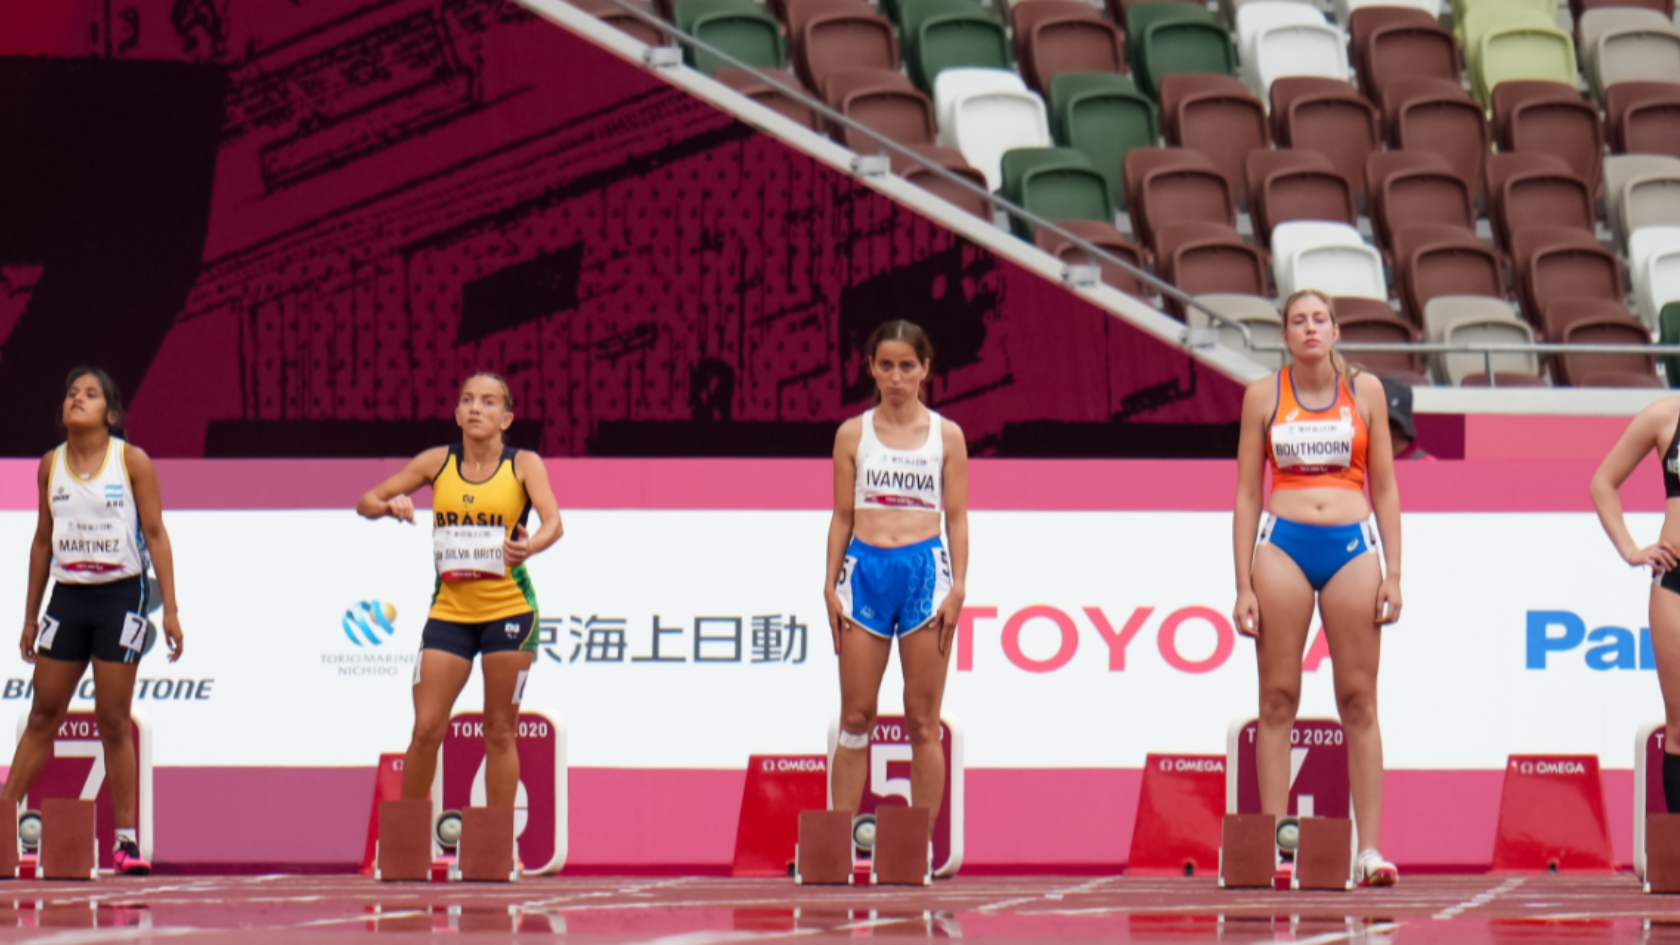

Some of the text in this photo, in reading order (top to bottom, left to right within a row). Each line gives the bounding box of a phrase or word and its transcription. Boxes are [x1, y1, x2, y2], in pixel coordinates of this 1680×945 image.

[1275, 440, 1350, 456] BOUTHOORN
[865, 468, 935, 491] IVANOVA
[436, 511, 504, 526] BRASIL
[59, 539, 120, 553] MARTINEZ
[445, 548, 470, 559] SILVA
[474, 548, 503, 559] BRITO
[130, 617, 144, 645] 7
[531, 614, 807, 664] 海上日動
[954, 605, 1333, 674] TOYO
[321, 653, 361, 664] TOKIO
[337, 666, 398, 676] NICHIDO
[2, 678, 214, 699] BGTONE
[451, 722, 548, 737] TOK 020
[1302, 728, 1343, 745] 2020
[53, 740, 106, 800] 7
[777, 759, 826, 772] OMEGA
[1175, 759, 1224, 772] OMEGA
[1536, 761, 1585, 774] OMEGA
